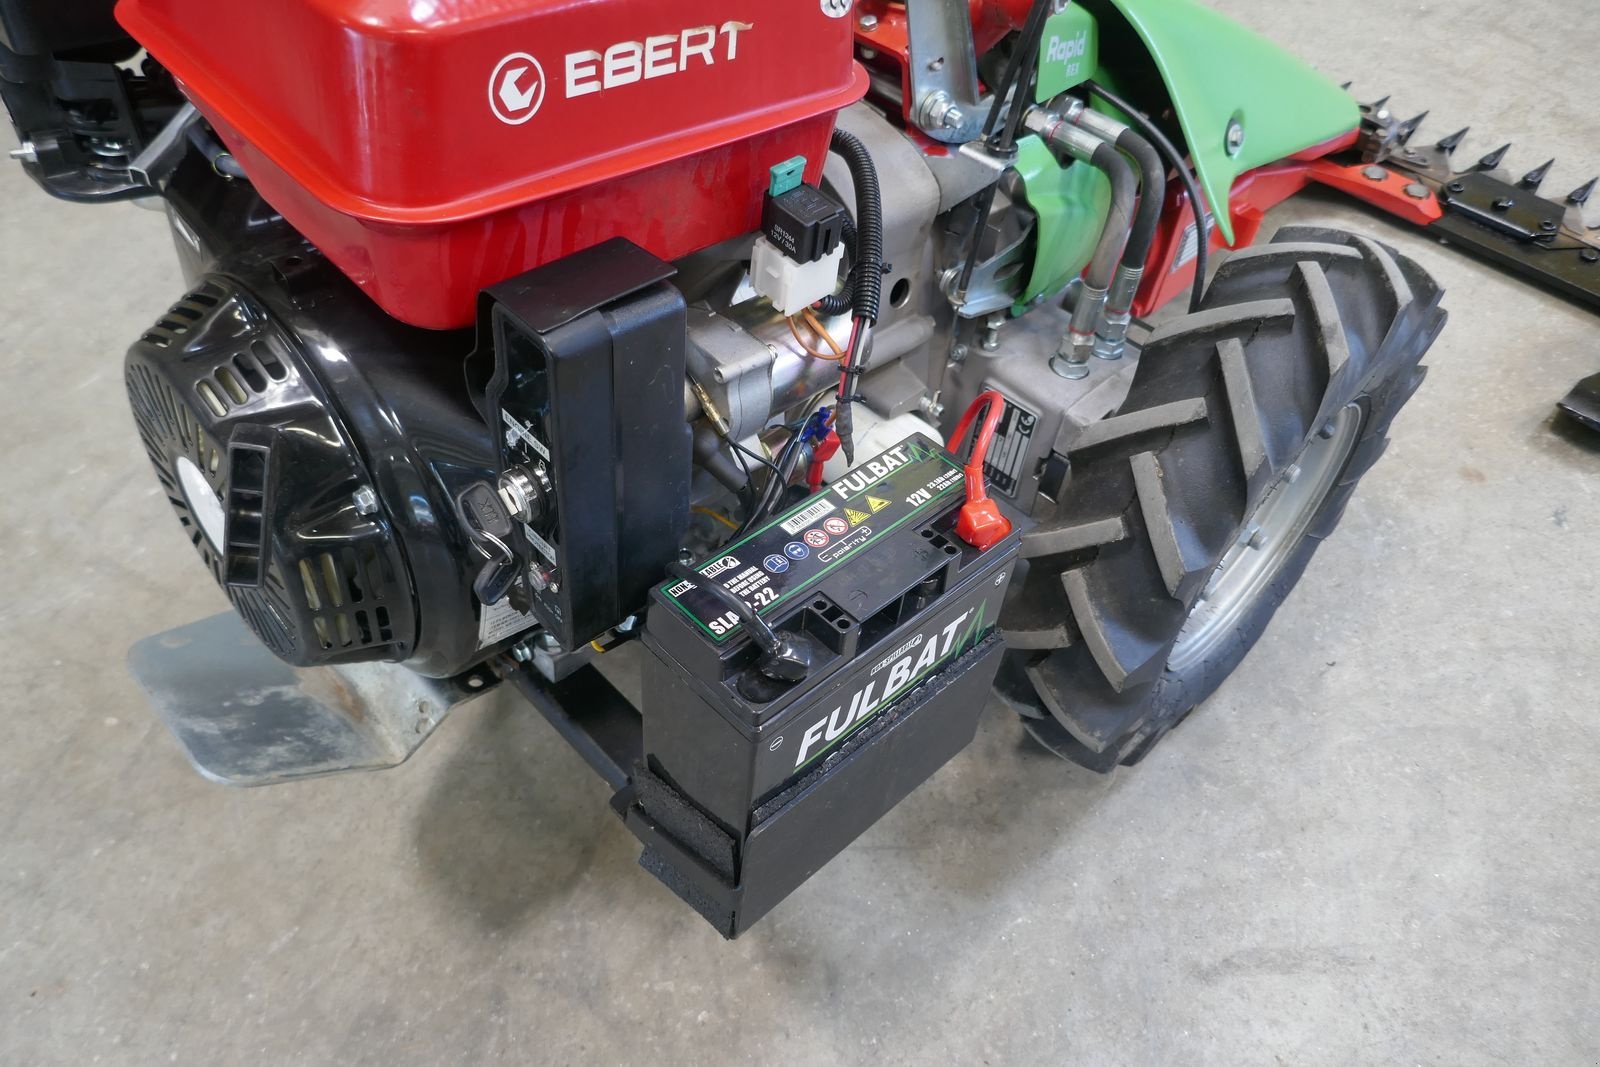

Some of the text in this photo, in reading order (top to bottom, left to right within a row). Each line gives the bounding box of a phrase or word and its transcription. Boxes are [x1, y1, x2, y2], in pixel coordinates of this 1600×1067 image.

[565, 21, 753, 98] EBERT
[1046, 30, 1087, 65] Rapid
[832, 446, 909, 500] FULBAT
[905, 488, 932, 507] 12V
[833, 536, 867, 559] polarity
[738, 588, 751, 596] THE
[795, 612, 968, 767] FULBAT
